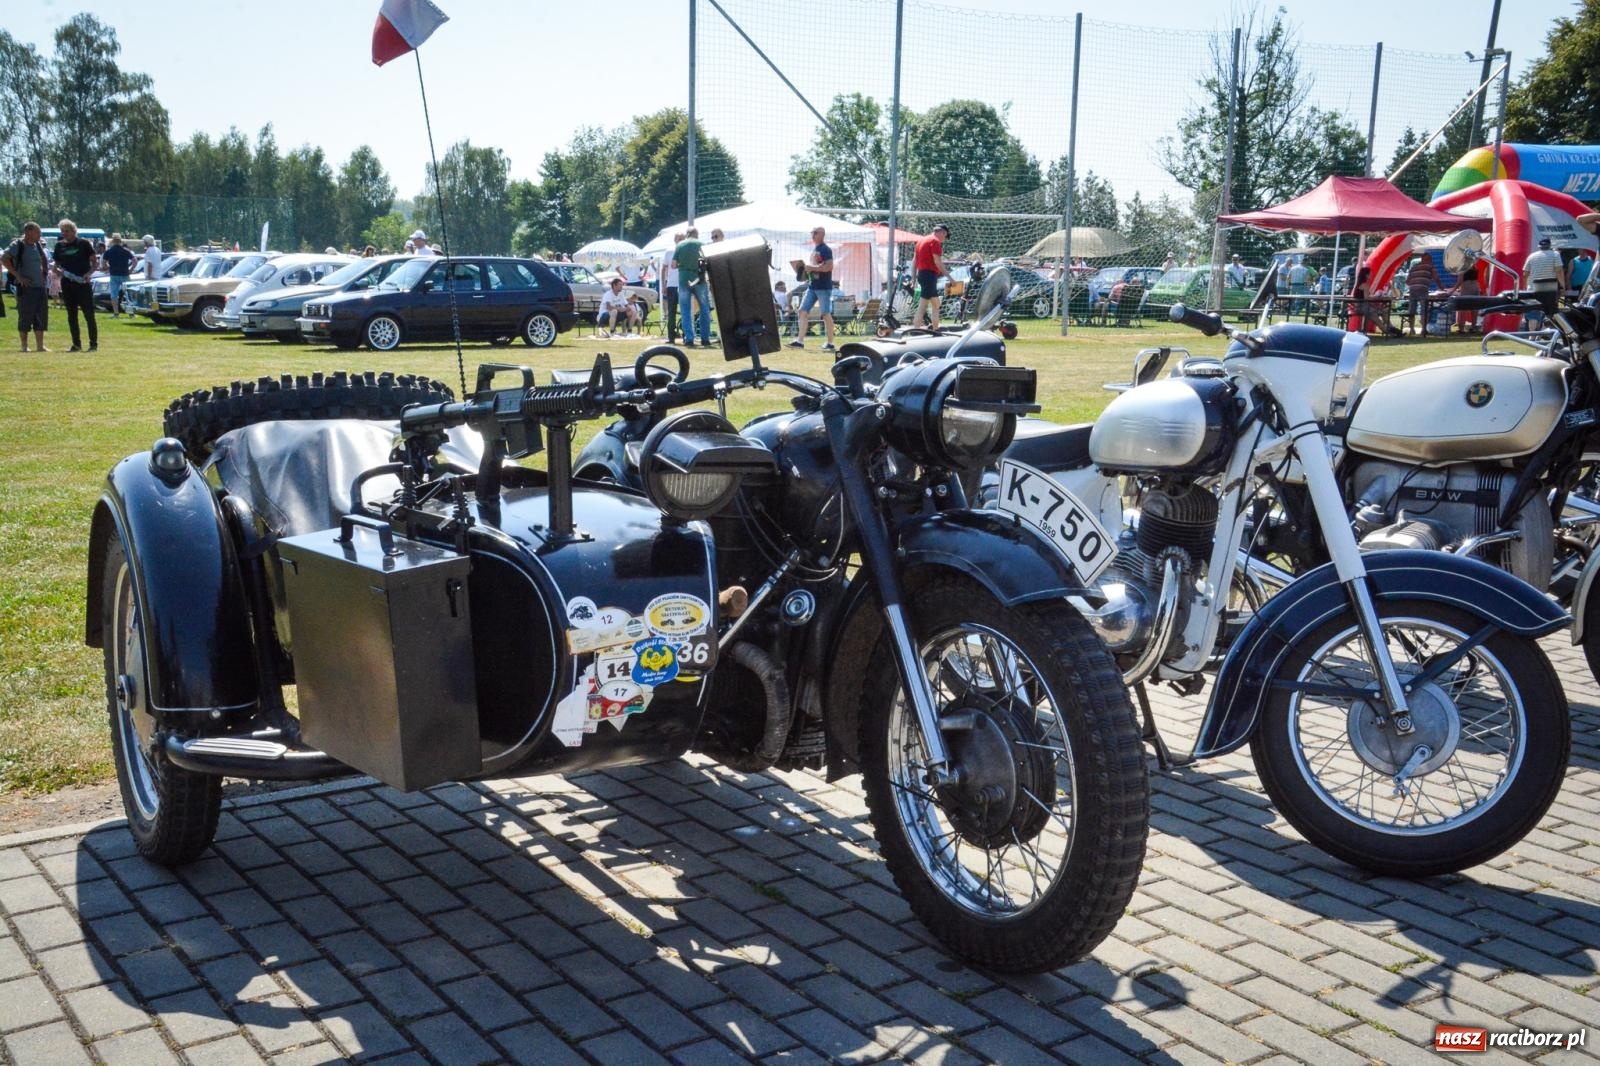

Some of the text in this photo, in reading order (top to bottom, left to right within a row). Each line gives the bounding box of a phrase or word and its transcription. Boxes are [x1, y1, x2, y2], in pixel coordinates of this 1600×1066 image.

[1537, 153, 1568, 164] GMINA
[1416, 490, 1461, 501] BMW
[1007, 468, 1101, 562] K-750
[1040, 520, 1056, 538] 1959
[601, 615, 613, 625] 12
[678, 643, 709, 663] 36
[607, 662, 631, 678] 14
[613, 688, 628, 697] 17
